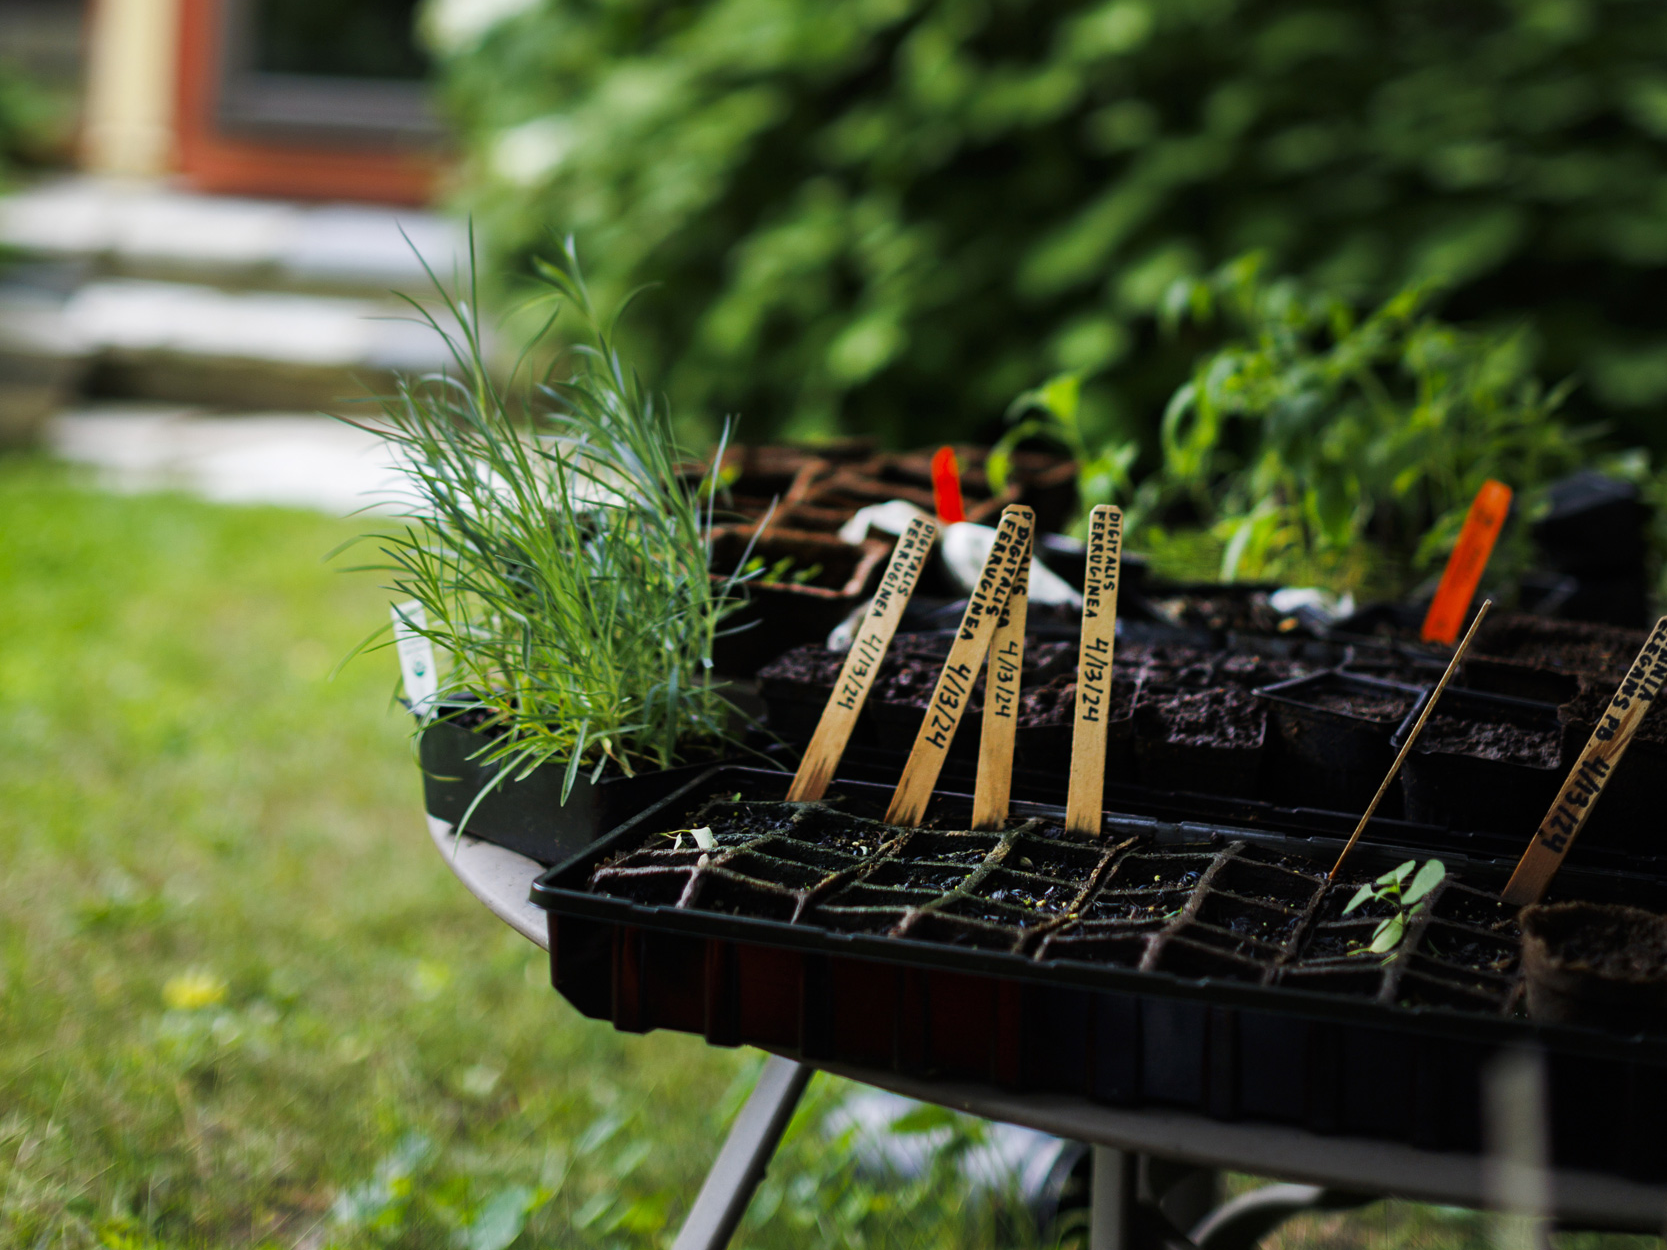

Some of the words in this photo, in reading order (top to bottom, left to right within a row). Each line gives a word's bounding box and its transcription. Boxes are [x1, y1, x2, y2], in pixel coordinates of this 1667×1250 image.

[871, 517, 924, 618] FERRUGINEA
[897, 523, 935, 598] DIGITALIS
[960, 519, 1016, 641] FERRUGINEA
[985, 525, 1030, 617] DIGITALIS
[1085, 511, 1107, 619] FERRUGINEA
[1103, 512, 1121, 591] DIGITALIS
[836, 634, 883, 711] 4/13/24
[925, 663, 972, 749] 4/13/24
[994, 641, 1019, 718] 4/13/24
[1082, 637, 1109, 722] 4/13/24
[1541, 755, 1610, 854] 4/13/24
